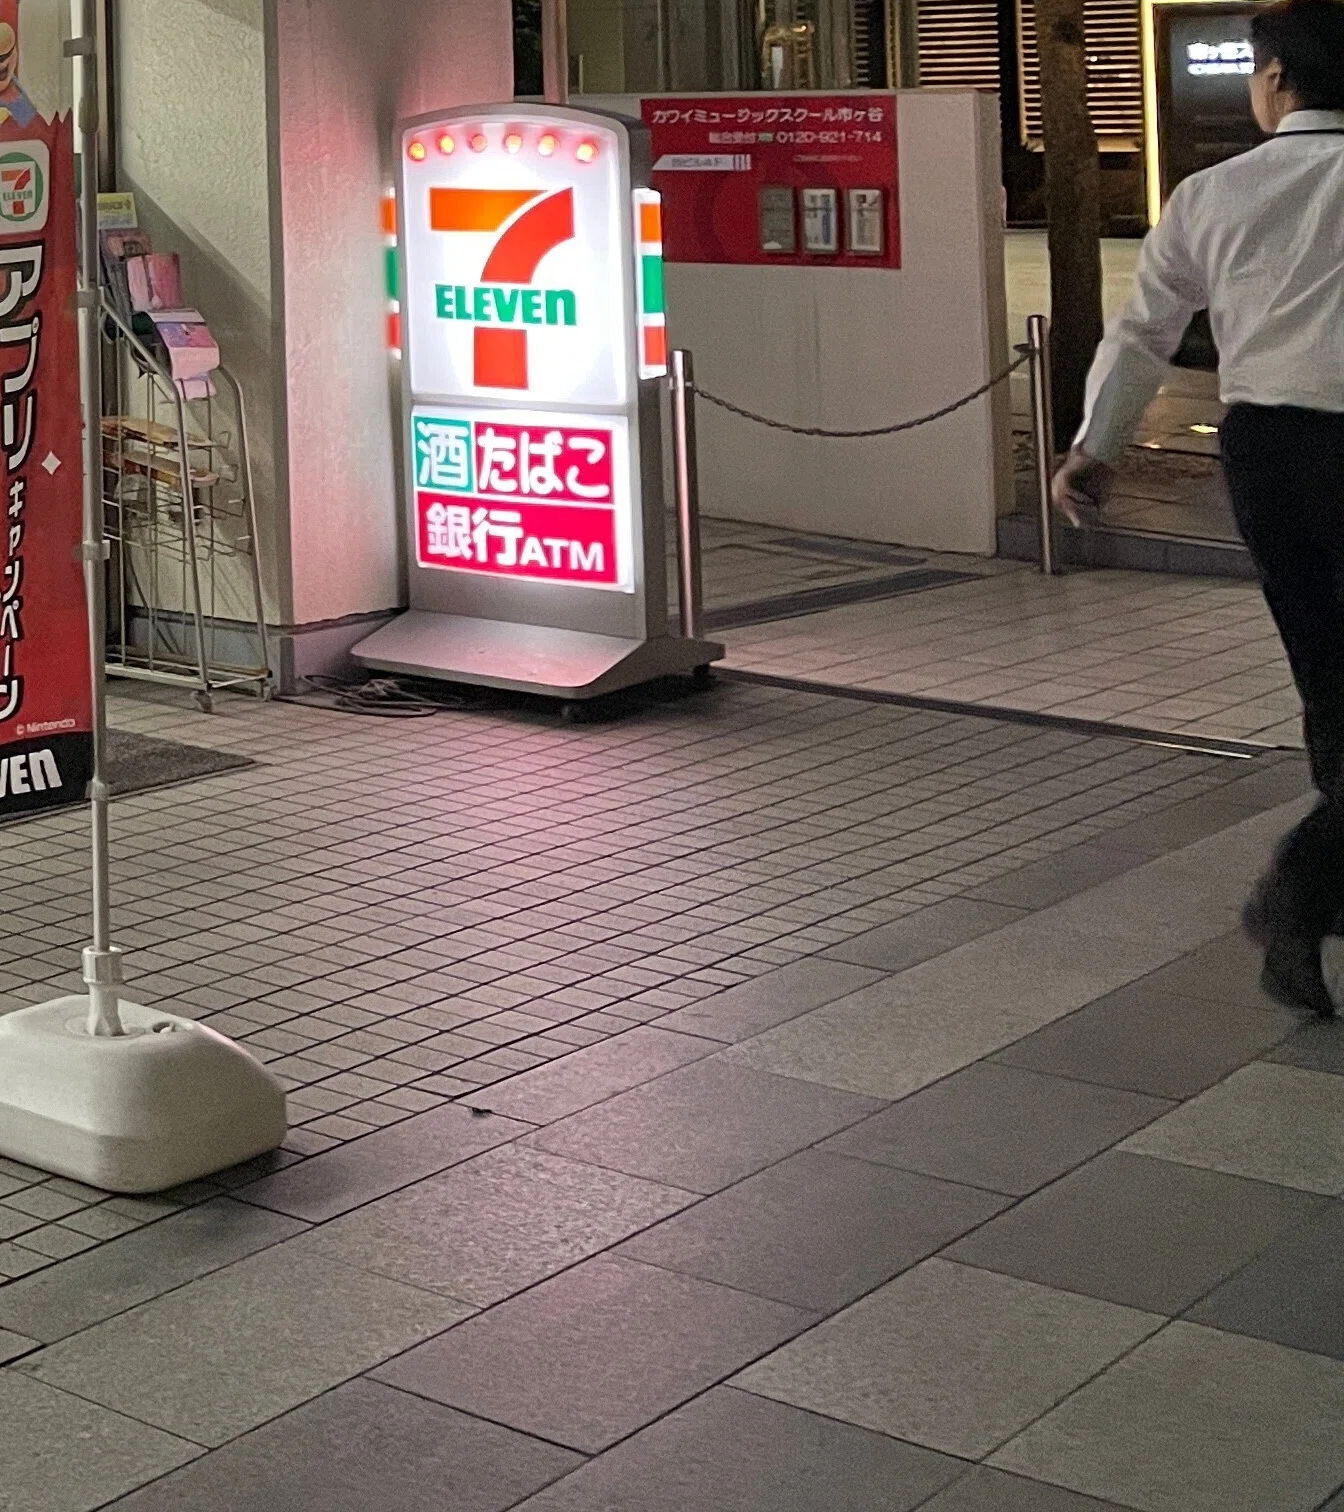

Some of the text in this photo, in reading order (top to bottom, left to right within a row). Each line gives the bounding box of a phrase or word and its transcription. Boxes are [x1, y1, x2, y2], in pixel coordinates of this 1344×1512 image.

[417, 419, 611, 500] 酒 たばこ
